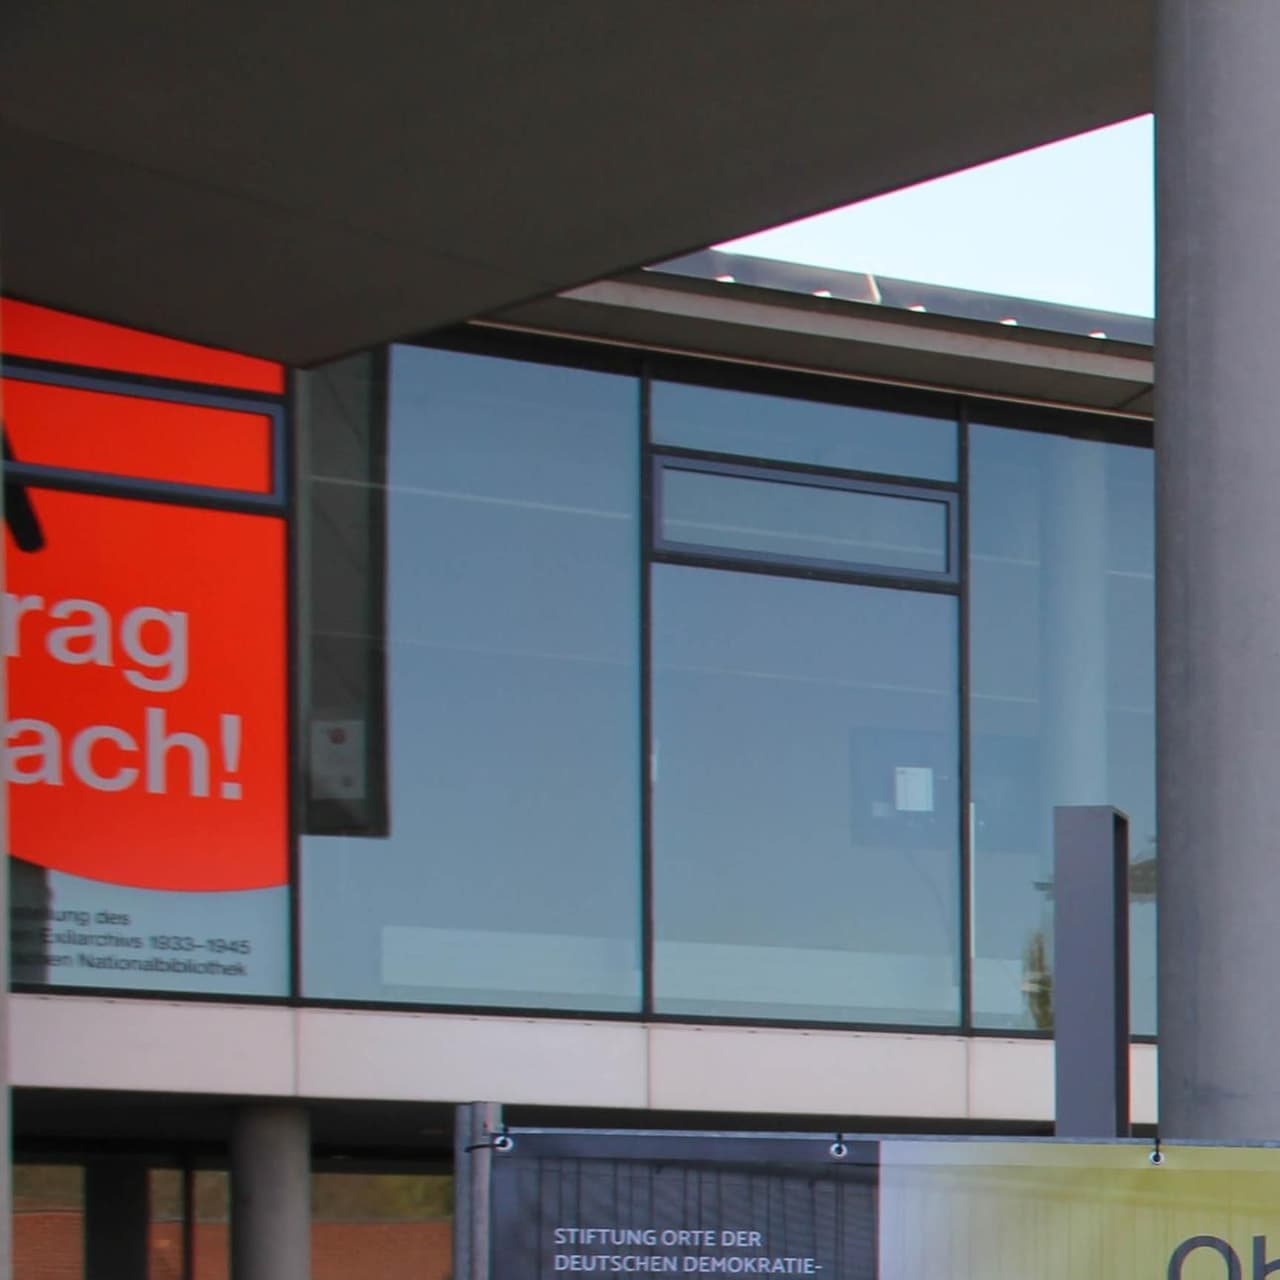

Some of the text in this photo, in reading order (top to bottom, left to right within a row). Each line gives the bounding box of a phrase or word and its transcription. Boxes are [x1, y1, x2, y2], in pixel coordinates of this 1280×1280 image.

[1, 591, 190, 693] rag
[4, 707, 243, 800] ach!
[95, 909, 131, 926] des
[78, 953, 248, 976] Nationalbibliothek
[554, 1228, 762, 1247] STIFTUNG ORTE DER
[554, 1255, 822, 1274] DEUTSCHEN DEMOKRATIE-
